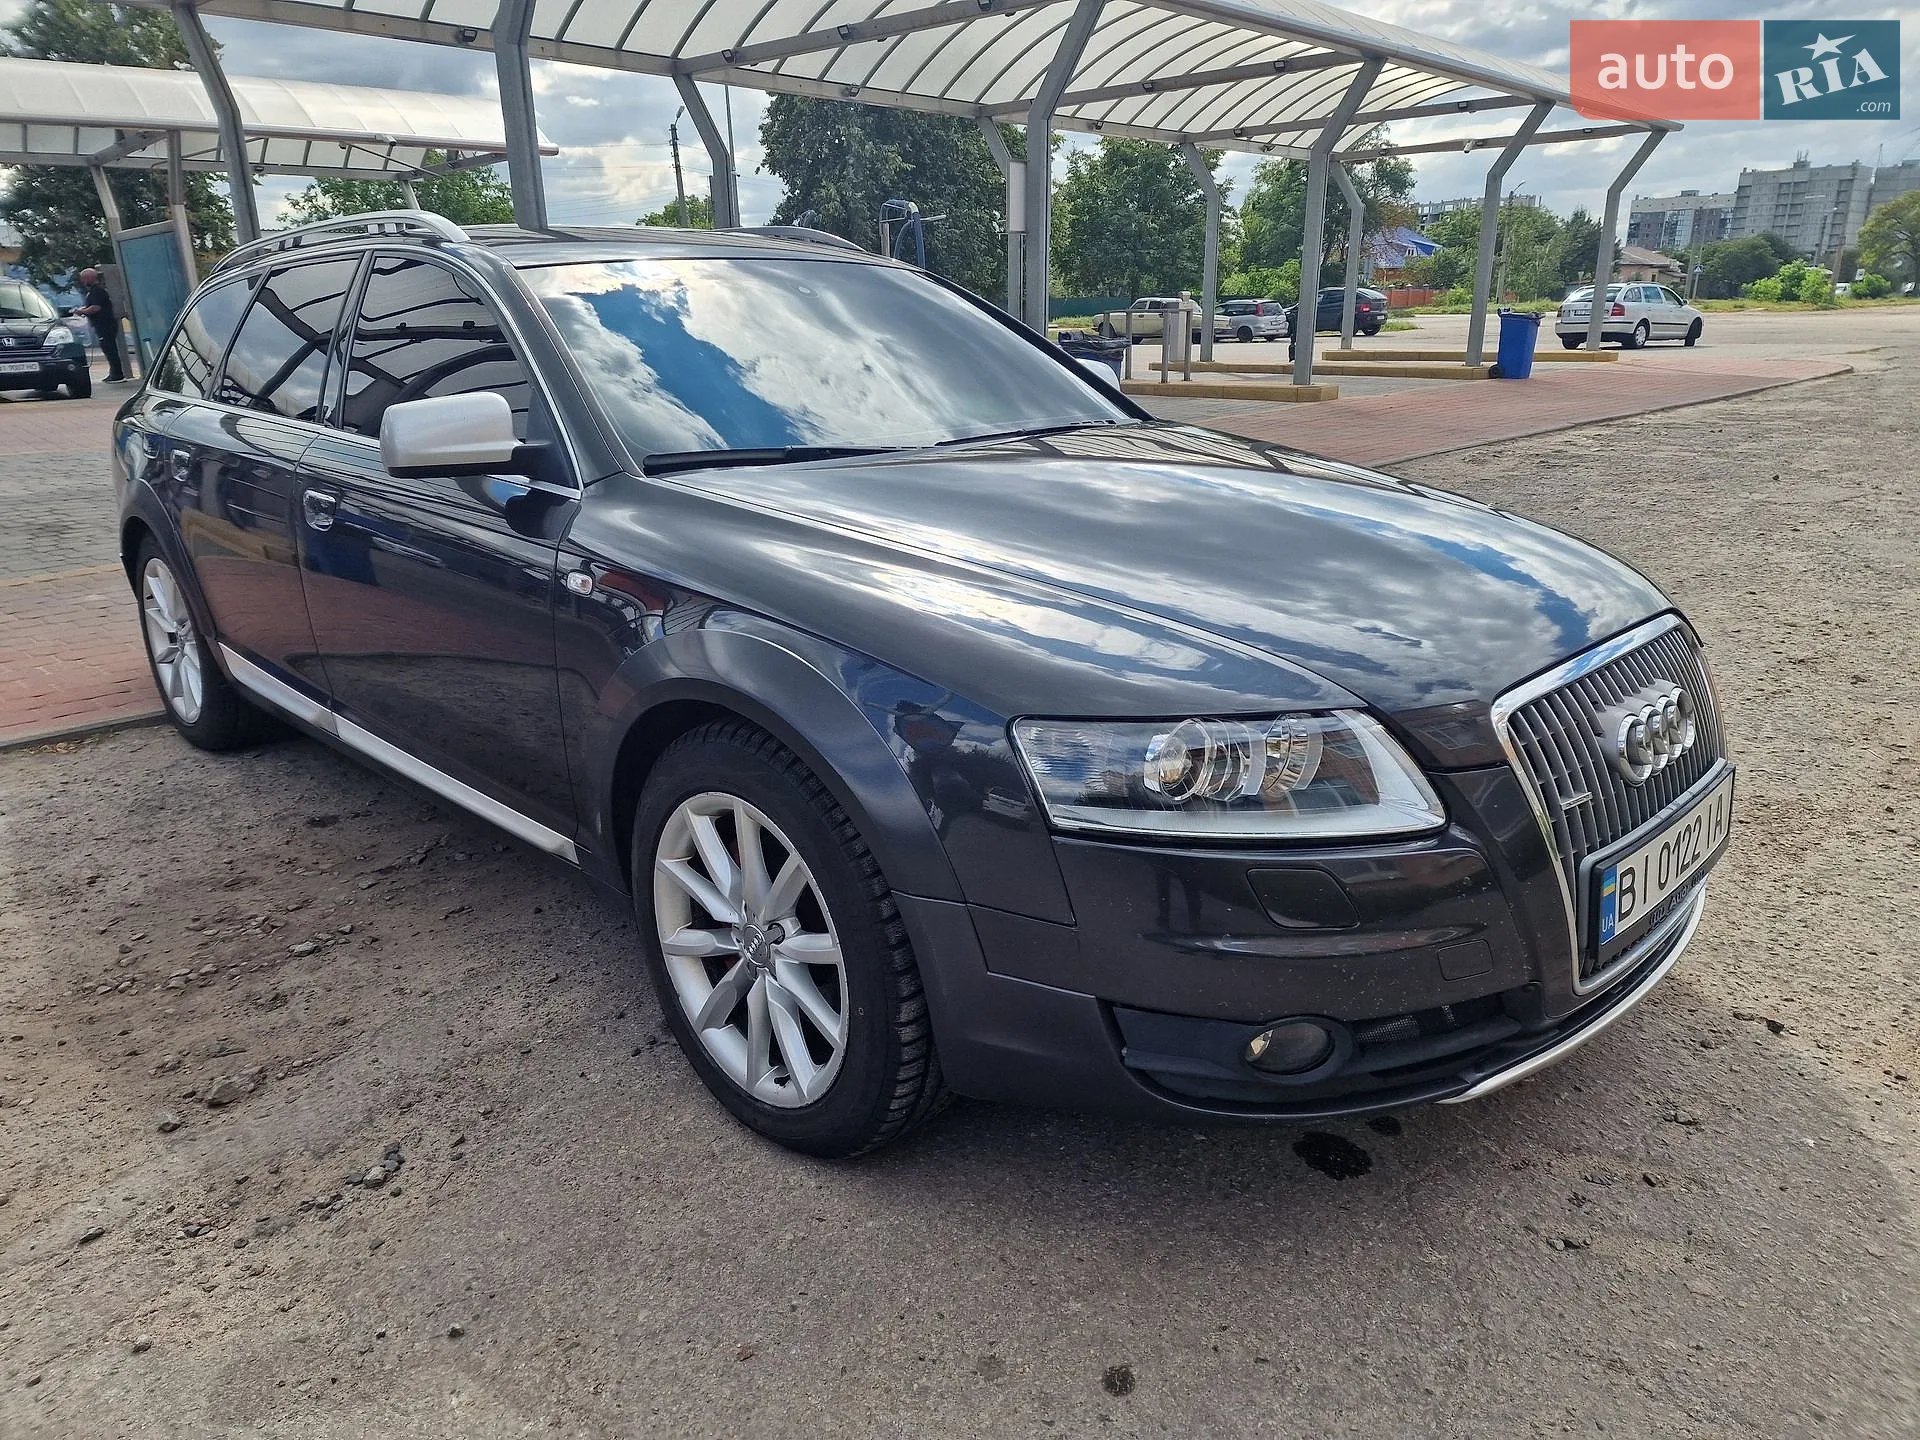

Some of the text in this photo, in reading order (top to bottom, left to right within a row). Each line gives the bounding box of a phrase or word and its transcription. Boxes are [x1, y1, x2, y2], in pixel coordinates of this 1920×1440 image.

[1618, 793, 1723, 922] BI 0122 IA
[1602, 914, 1614, 932] UA
